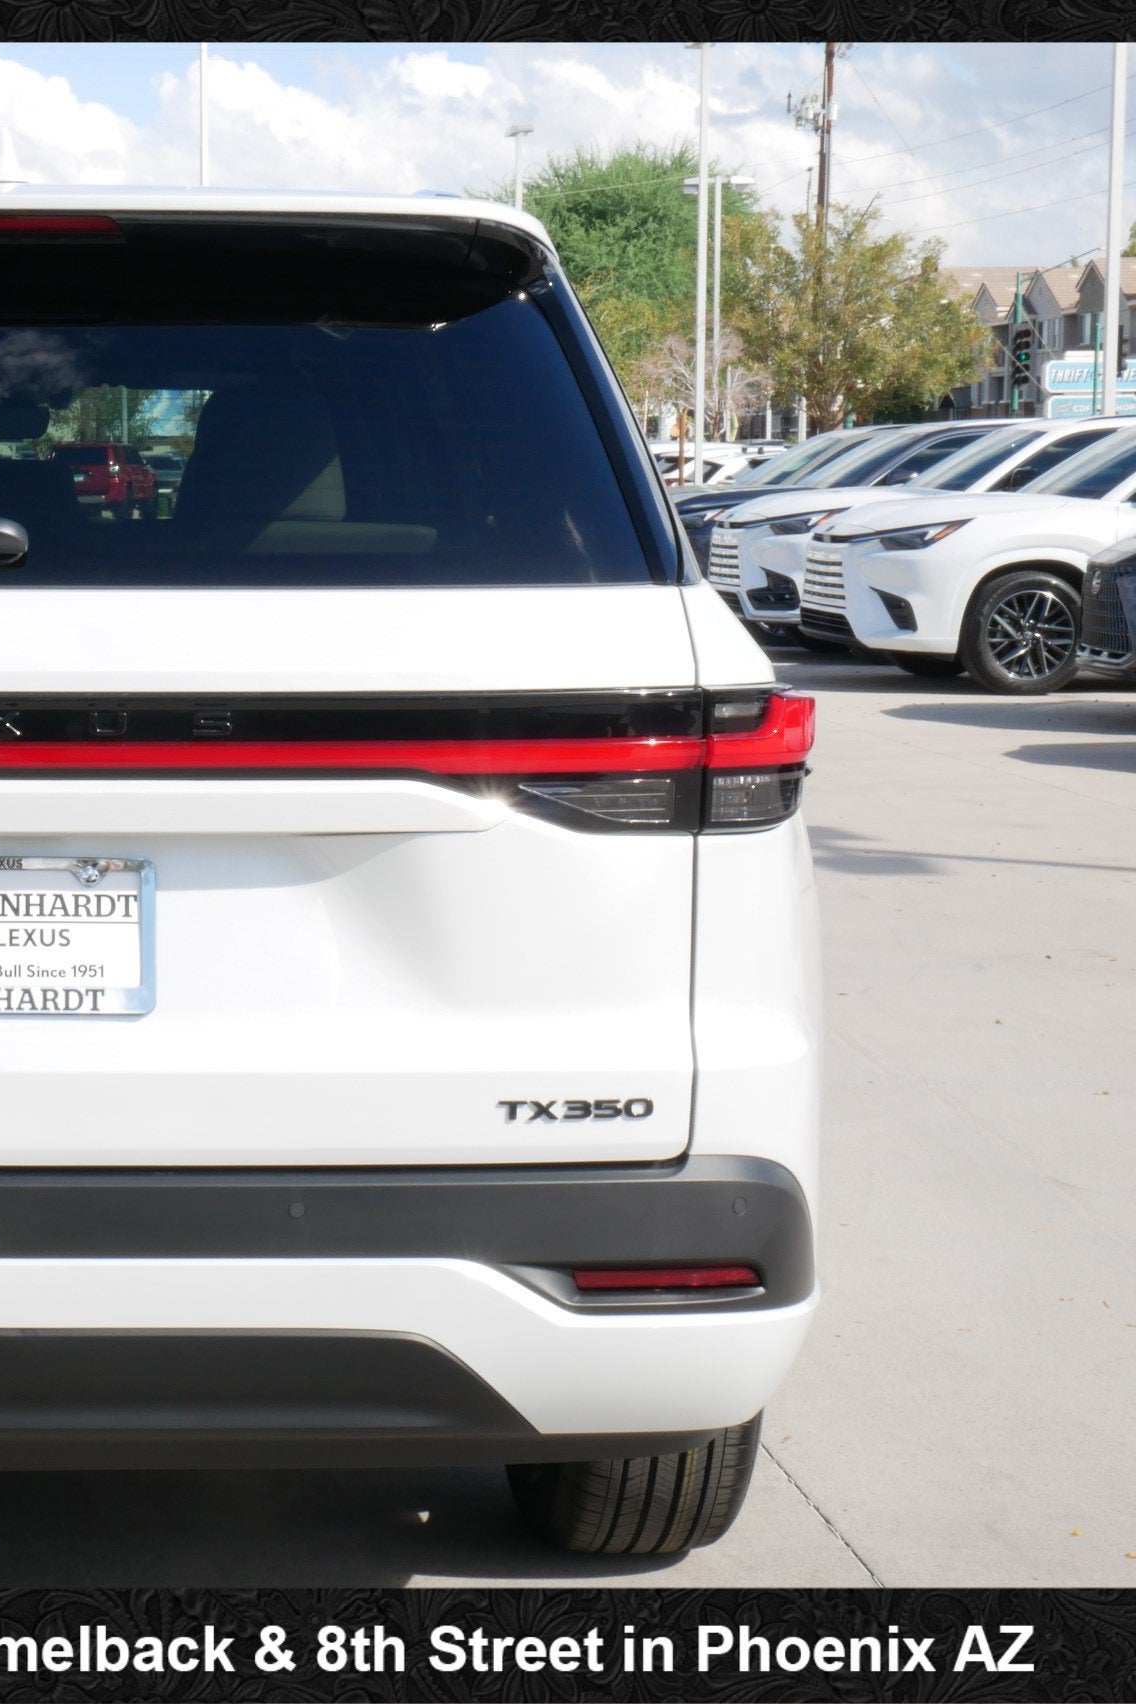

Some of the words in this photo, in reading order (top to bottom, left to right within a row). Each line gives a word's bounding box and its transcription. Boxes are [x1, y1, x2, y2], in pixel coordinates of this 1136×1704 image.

[1051, 368, 1089, 383] THRIFT
[1072, 403, 1105, 413] COFE
[27, 964, 66, 978] Since
[71, 964, 105, 978] 1951
